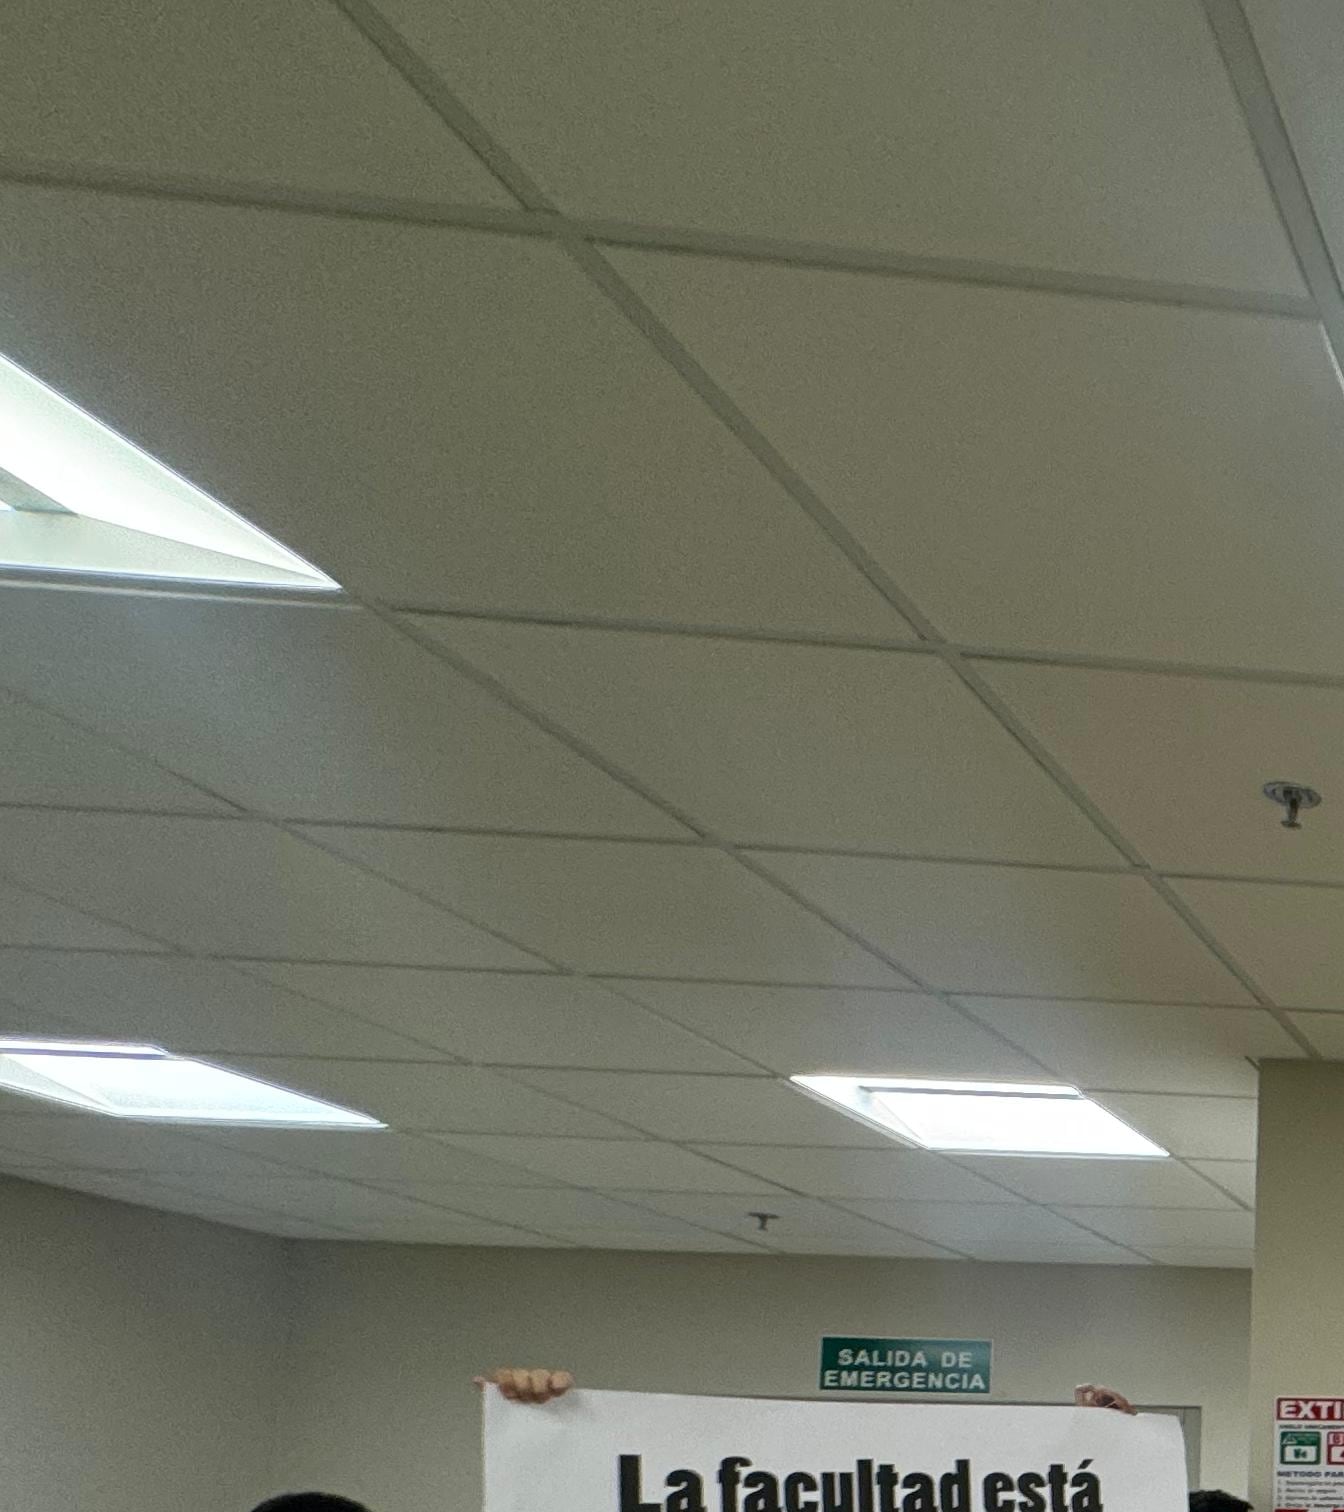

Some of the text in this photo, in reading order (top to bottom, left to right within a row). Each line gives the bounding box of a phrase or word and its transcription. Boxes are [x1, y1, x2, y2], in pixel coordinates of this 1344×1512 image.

[838, 1348, 973, 1368] SALIDA DE
[824, 1370, 986, 1390] EMERGENCIA
